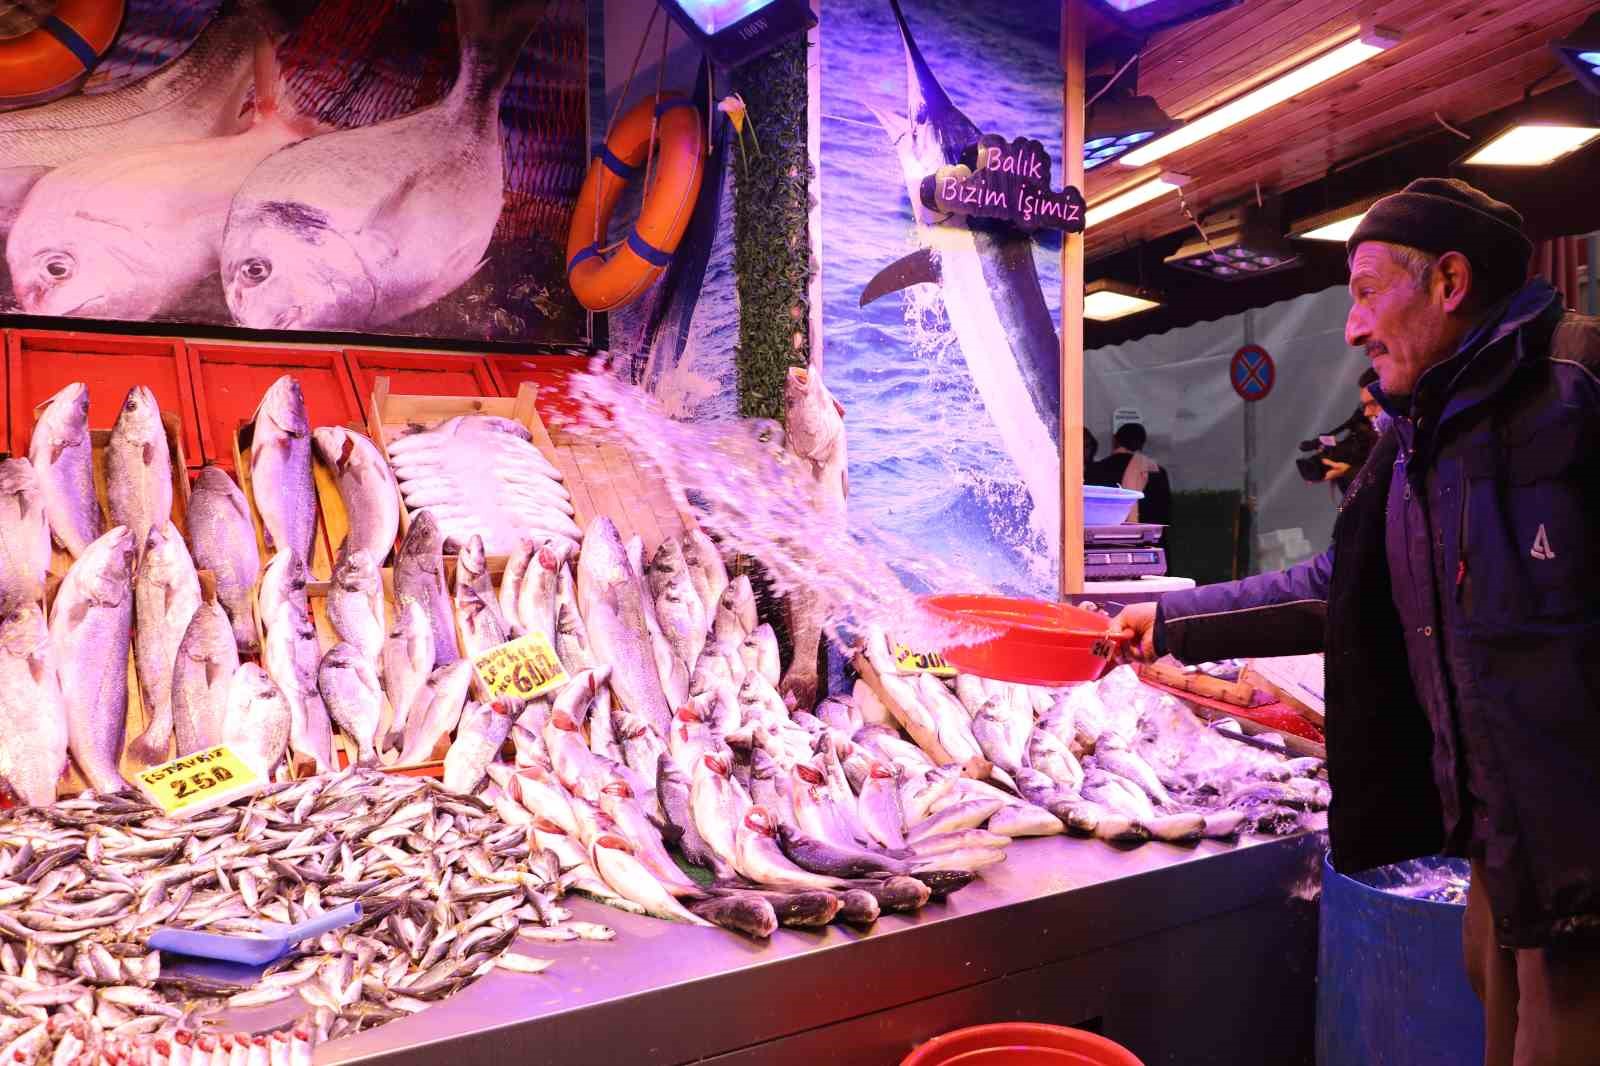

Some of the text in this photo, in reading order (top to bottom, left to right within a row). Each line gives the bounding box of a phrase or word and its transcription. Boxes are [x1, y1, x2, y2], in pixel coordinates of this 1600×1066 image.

[986, 147, 1042, 179] Balık
[942, 176, 1080, 221] Bizim İşimiz
[169, 766, 234, 799] 250
